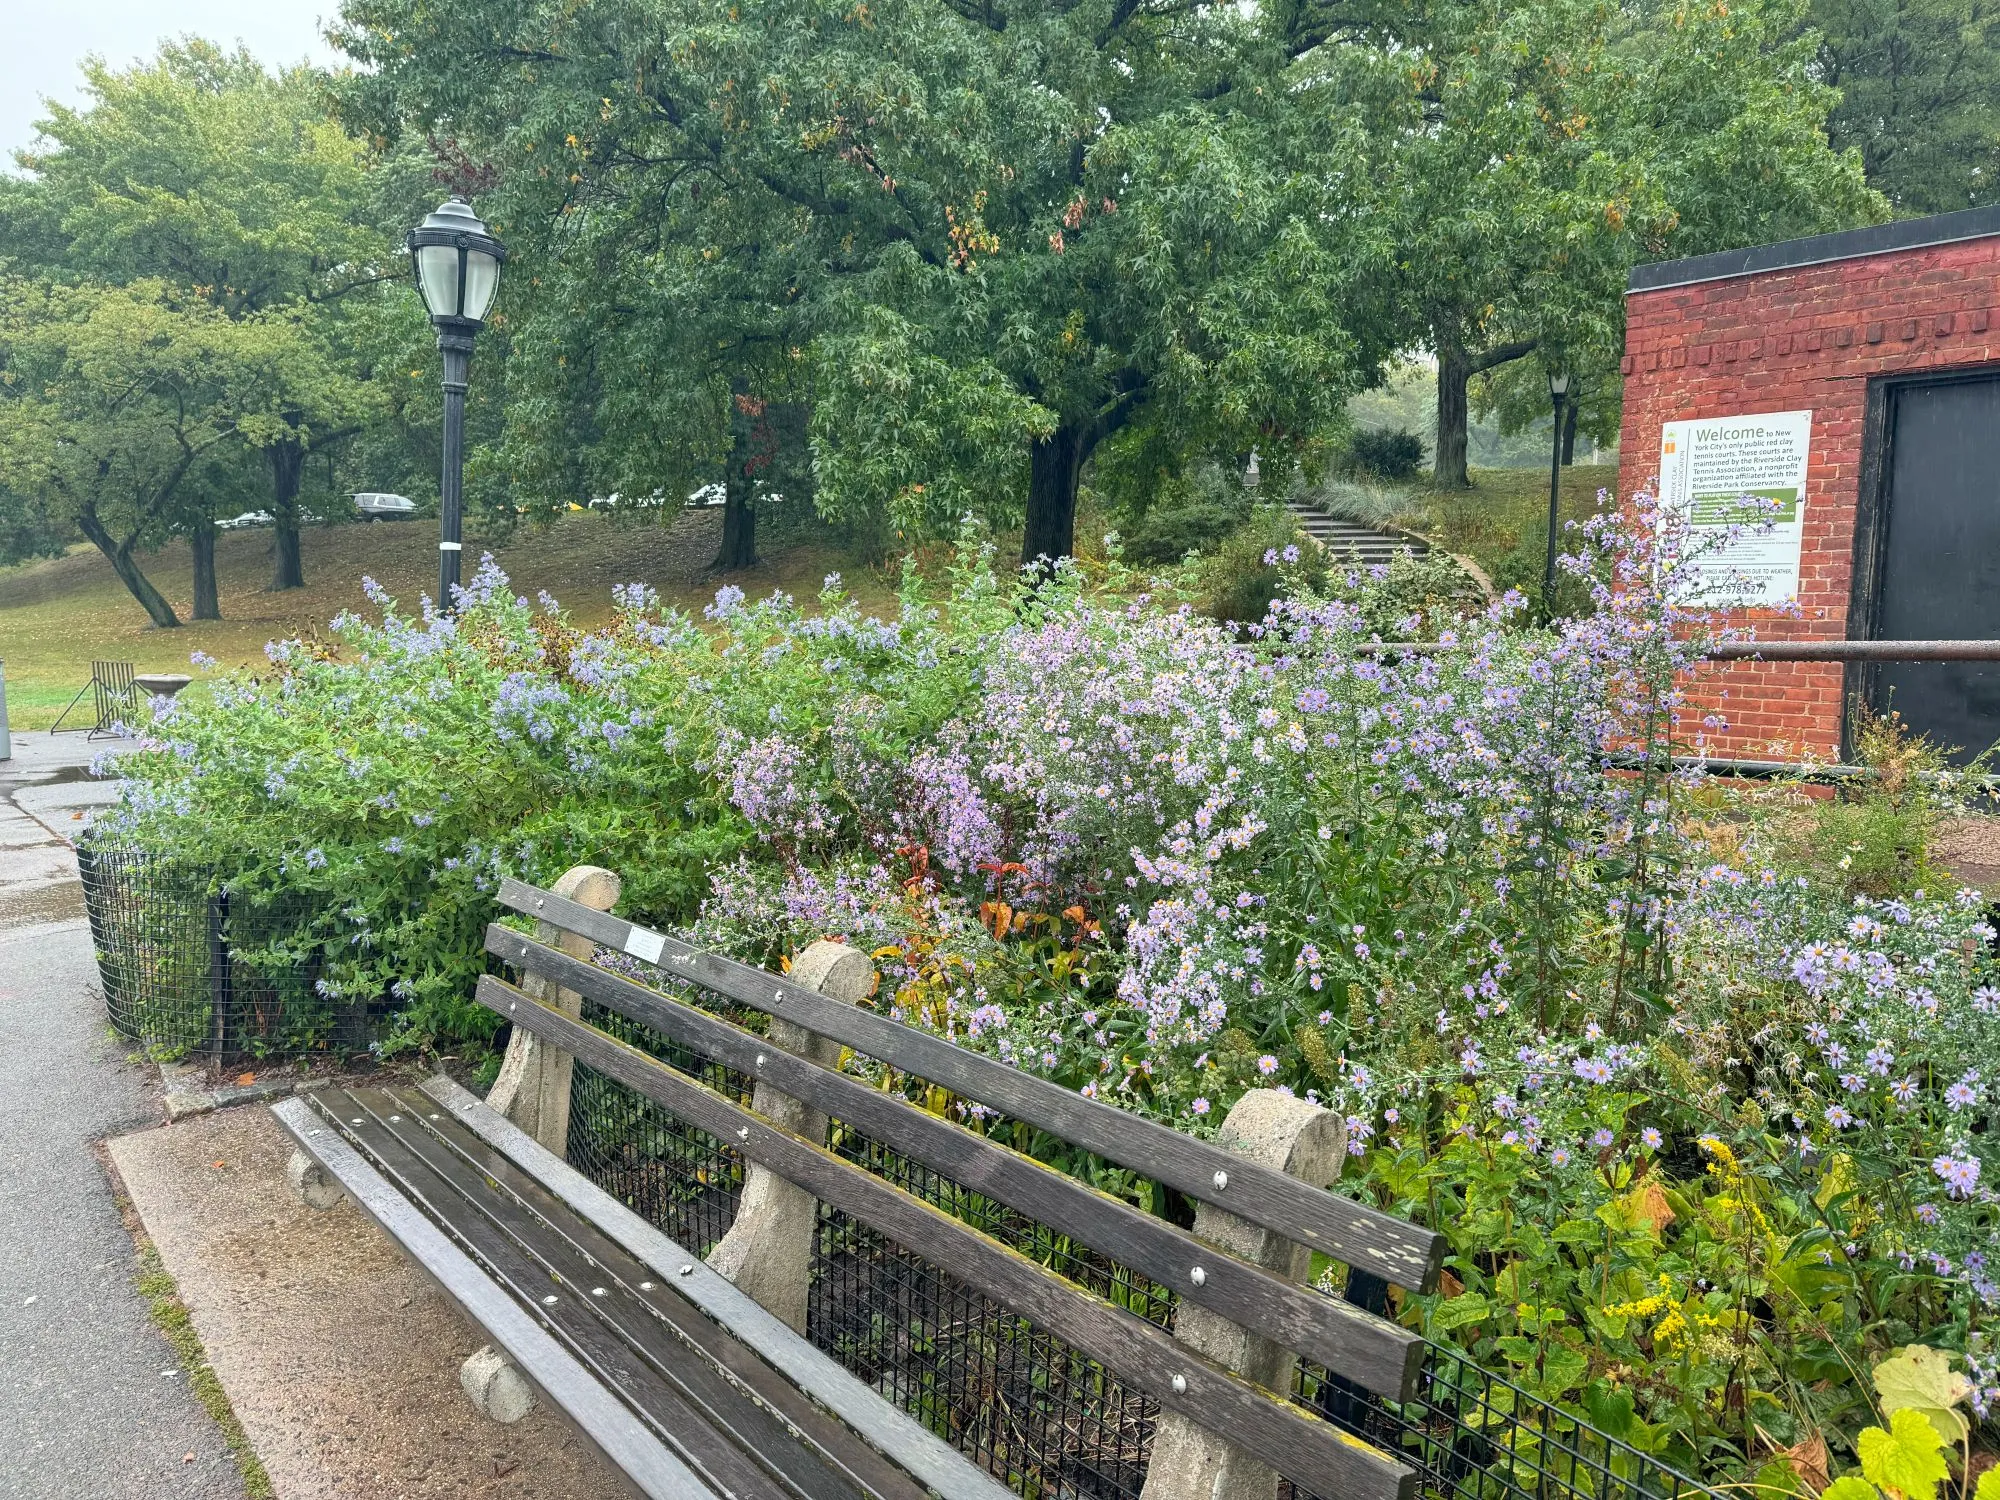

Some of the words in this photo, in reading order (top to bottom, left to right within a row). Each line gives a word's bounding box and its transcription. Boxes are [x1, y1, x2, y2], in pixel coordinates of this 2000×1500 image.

[1696, 427, 1764, 442] Welcome
[1744, 440, 1765, 449] public
[1780, 438, 1793, 446] clay
[1754, 455, 1784, 463] Riverside
[1764, 463, 1798, 471] nonprofit
[1693, 474, 1733, 483] organization
[1707, 585, 1766, 594] 212-978-277
